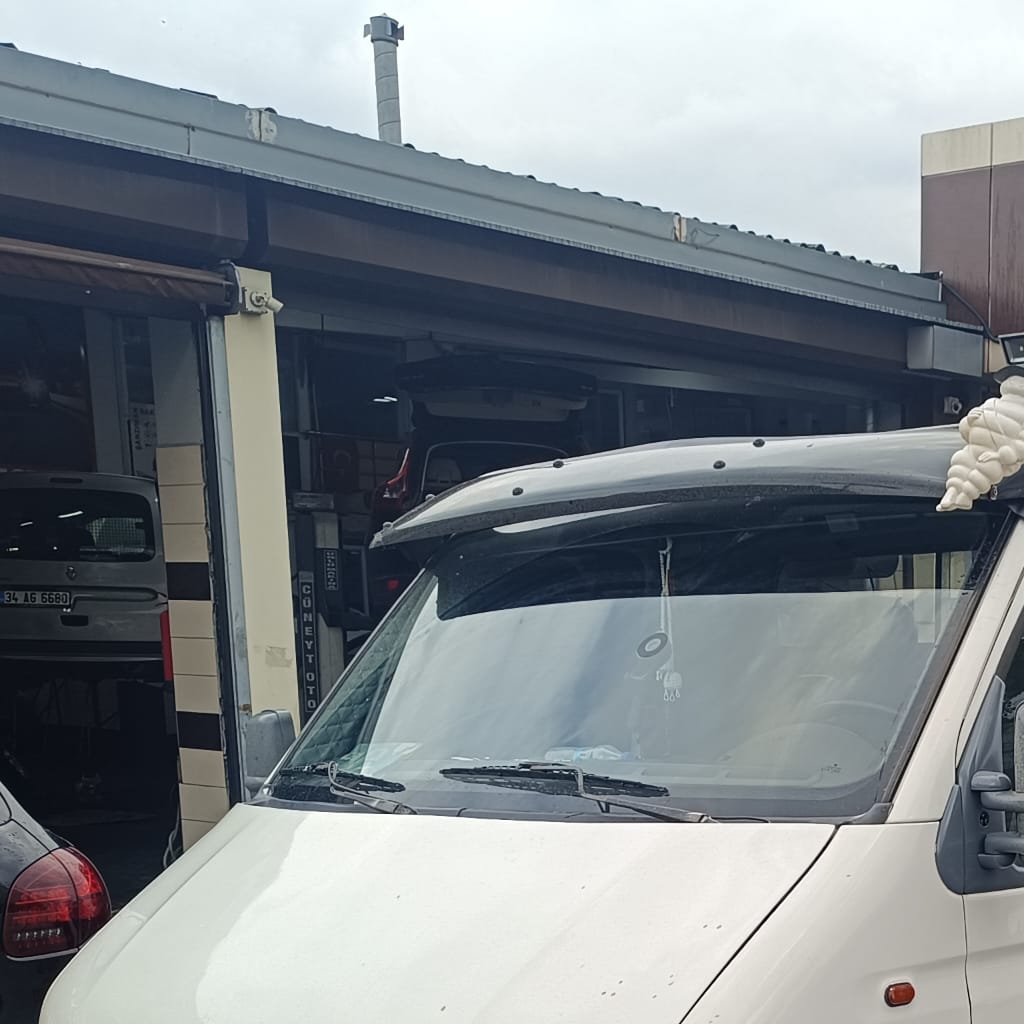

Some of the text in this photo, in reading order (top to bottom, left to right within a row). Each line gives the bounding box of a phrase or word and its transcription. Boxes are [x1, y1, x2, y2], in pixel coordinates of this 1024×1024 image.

[5, 592, 18, 603] 34
[23, 592, 37, 603] AG
[306, 671, 317, 709] OTO
